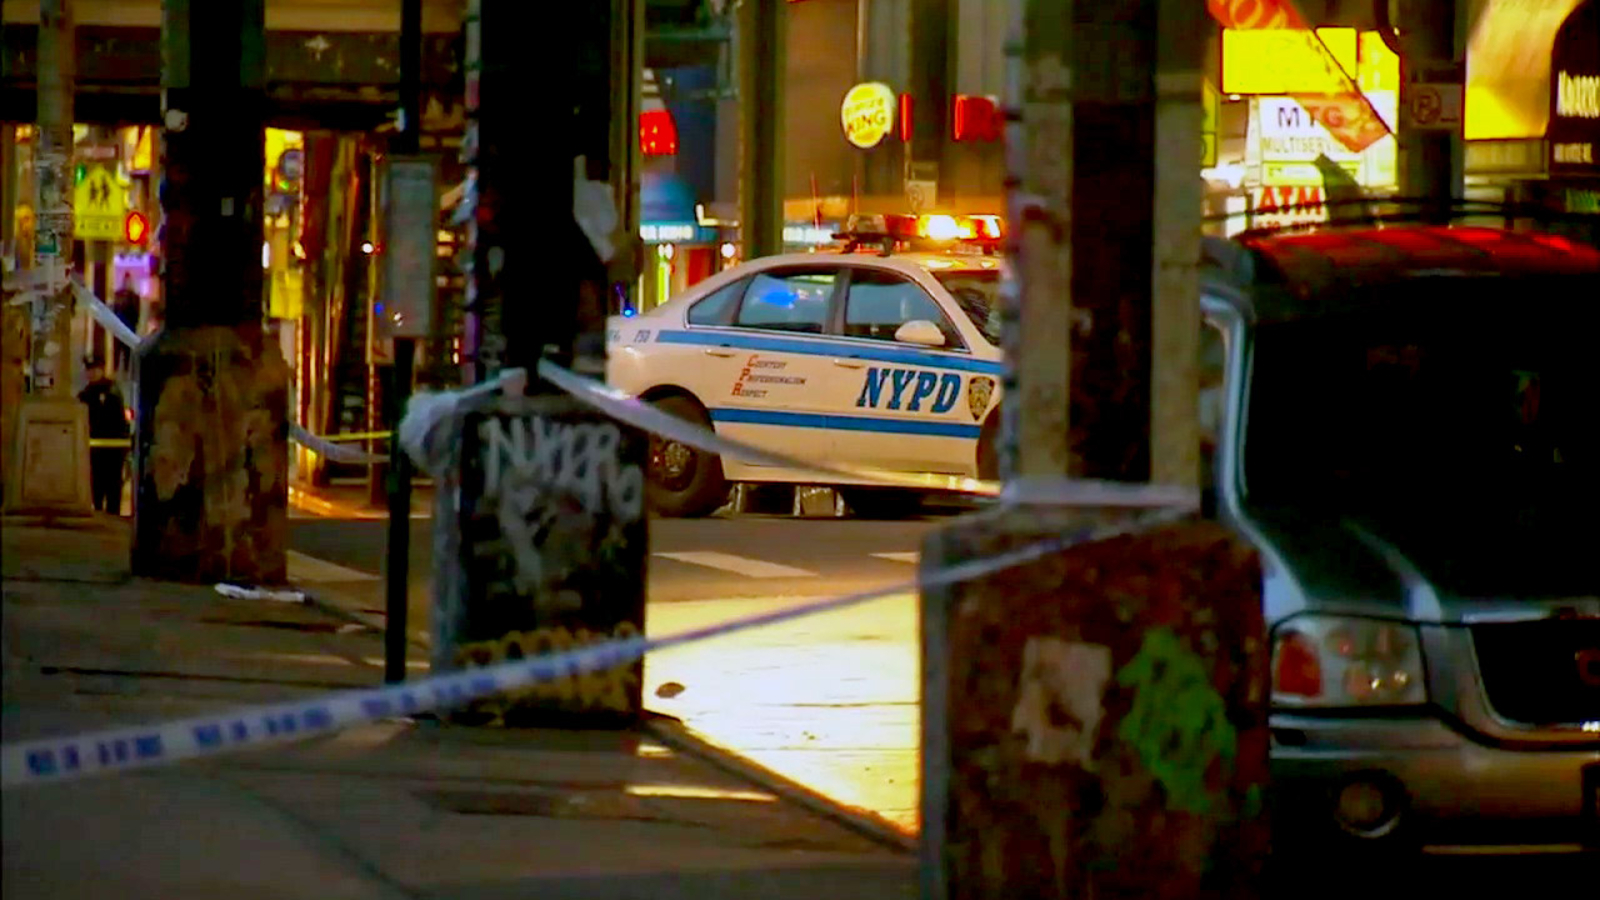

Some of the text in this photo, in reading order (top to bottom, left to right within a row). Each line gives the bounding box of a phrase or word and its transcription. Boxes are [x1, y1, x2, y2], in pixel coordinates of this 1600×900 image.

[847, 110, 886, 134] KING
[1259, 186, 1322, 214] ATM
[856, 367, 961, 413] NYPD
